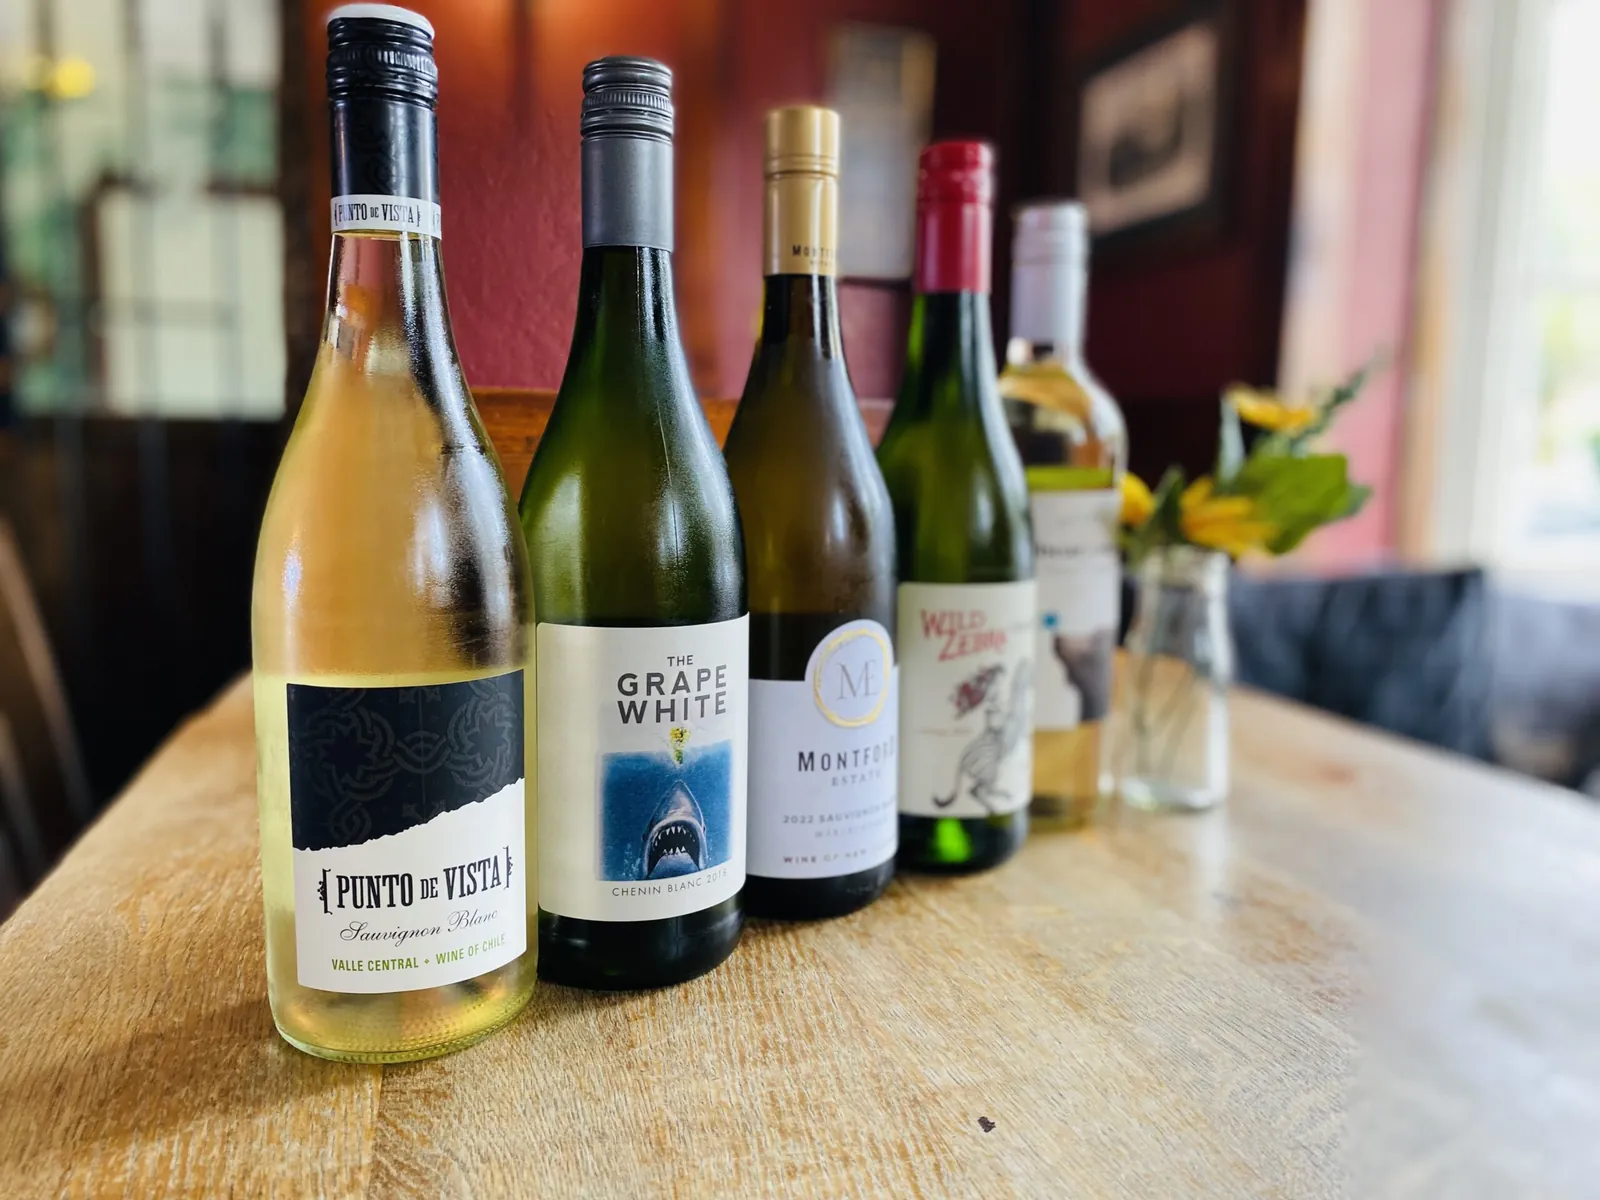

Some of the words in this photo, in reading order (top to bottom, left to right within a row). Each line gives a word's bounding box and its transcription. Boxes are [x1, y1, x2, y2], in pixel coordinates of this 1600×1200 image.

[381, 203, 414, 223] VISTA
[667, 654, 694, 667] THE
[617, 664, 727, 697] GRAPE
[617, 690, 727, 724] WHITE
[336, 872, 413, 909] PUNTO
[420, 876, 438, 900] DE
[443, 854, 502, 900] VISTA
[612, 886, 661, 897] CHENIN
[667, 877, 702, 893] BLANC
[340, 921, 441, 947] Sauvignon
[448, 908, 498, 932] Blanc
[332, 957, 364, 972] VALLE
[367, 956, 419, 972] CENTRAL
[436, 948, 465, 965] WINE
[468, 943, 480, 957] OF
[482, 932, 506, 953] CHILE
